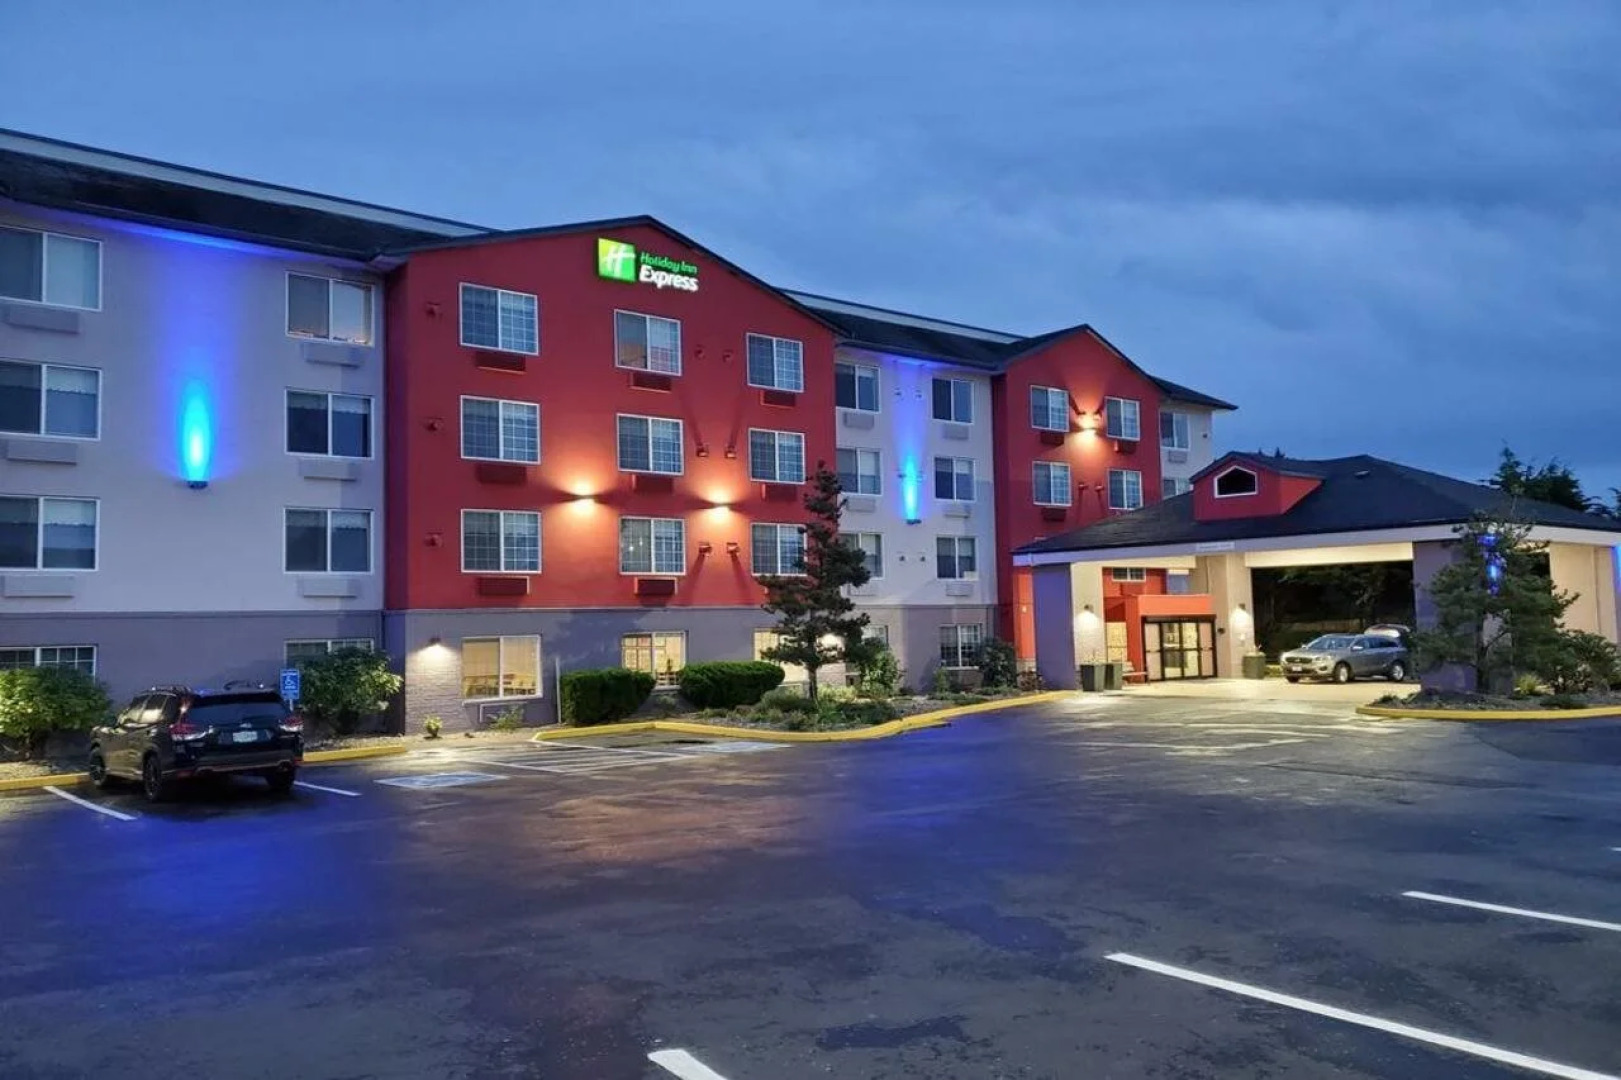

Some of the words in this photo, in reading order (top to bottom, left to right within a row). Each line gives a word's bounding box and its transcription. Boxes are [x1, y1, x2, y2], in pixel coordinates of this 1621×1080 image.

[640, 252, 680, 272] Holiday
[680, 261, 698, 274] Inn
[639, 264, 699, 292] Express
